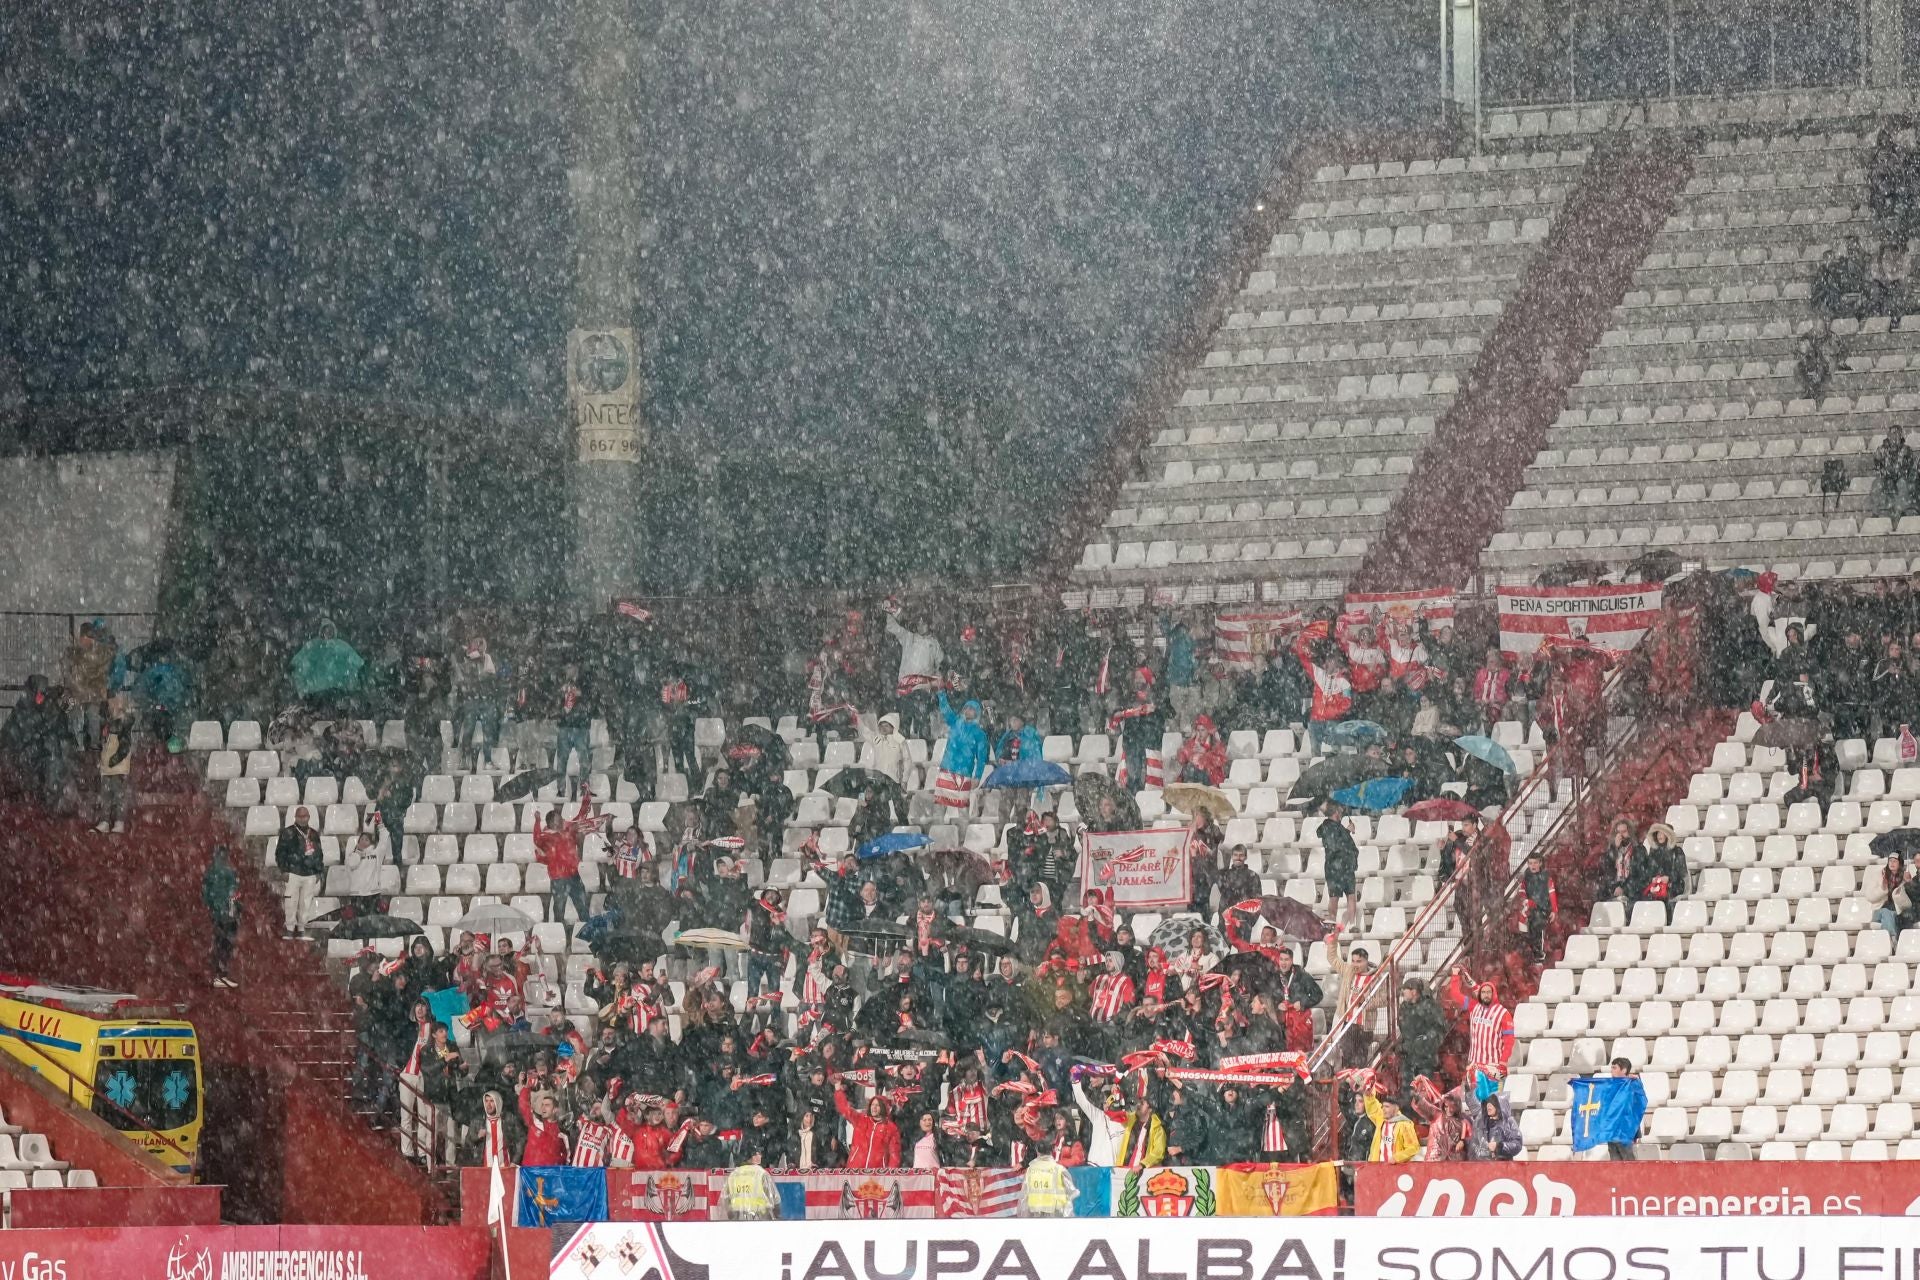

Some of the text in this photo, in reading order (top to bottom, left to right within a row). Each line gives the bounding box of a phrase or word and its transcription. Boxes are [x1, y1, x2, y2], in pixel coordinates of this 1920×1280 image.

[589, 439, 616, 452] 667
[1510, 596, 1645, 613] PEÑA SPORTINGUISTA
[1119, 860, 1161, 872] DEJARÉ
[19, 1010, 62, 1038] U.V.I.
[121, 1039, 173, 1059] U.V.I.
[1034, 1180, 1049, 1189] 014
[23, 1251, 67, 1280] Gas
[221, 1250, 344, 1280] AMBUEMERGENCIAS
[1377, 1246, 1671, 1280] SOMOS
[1700, 1246, 1805, 1280] TU
[1838, 1246, 1920, 1280] FI
